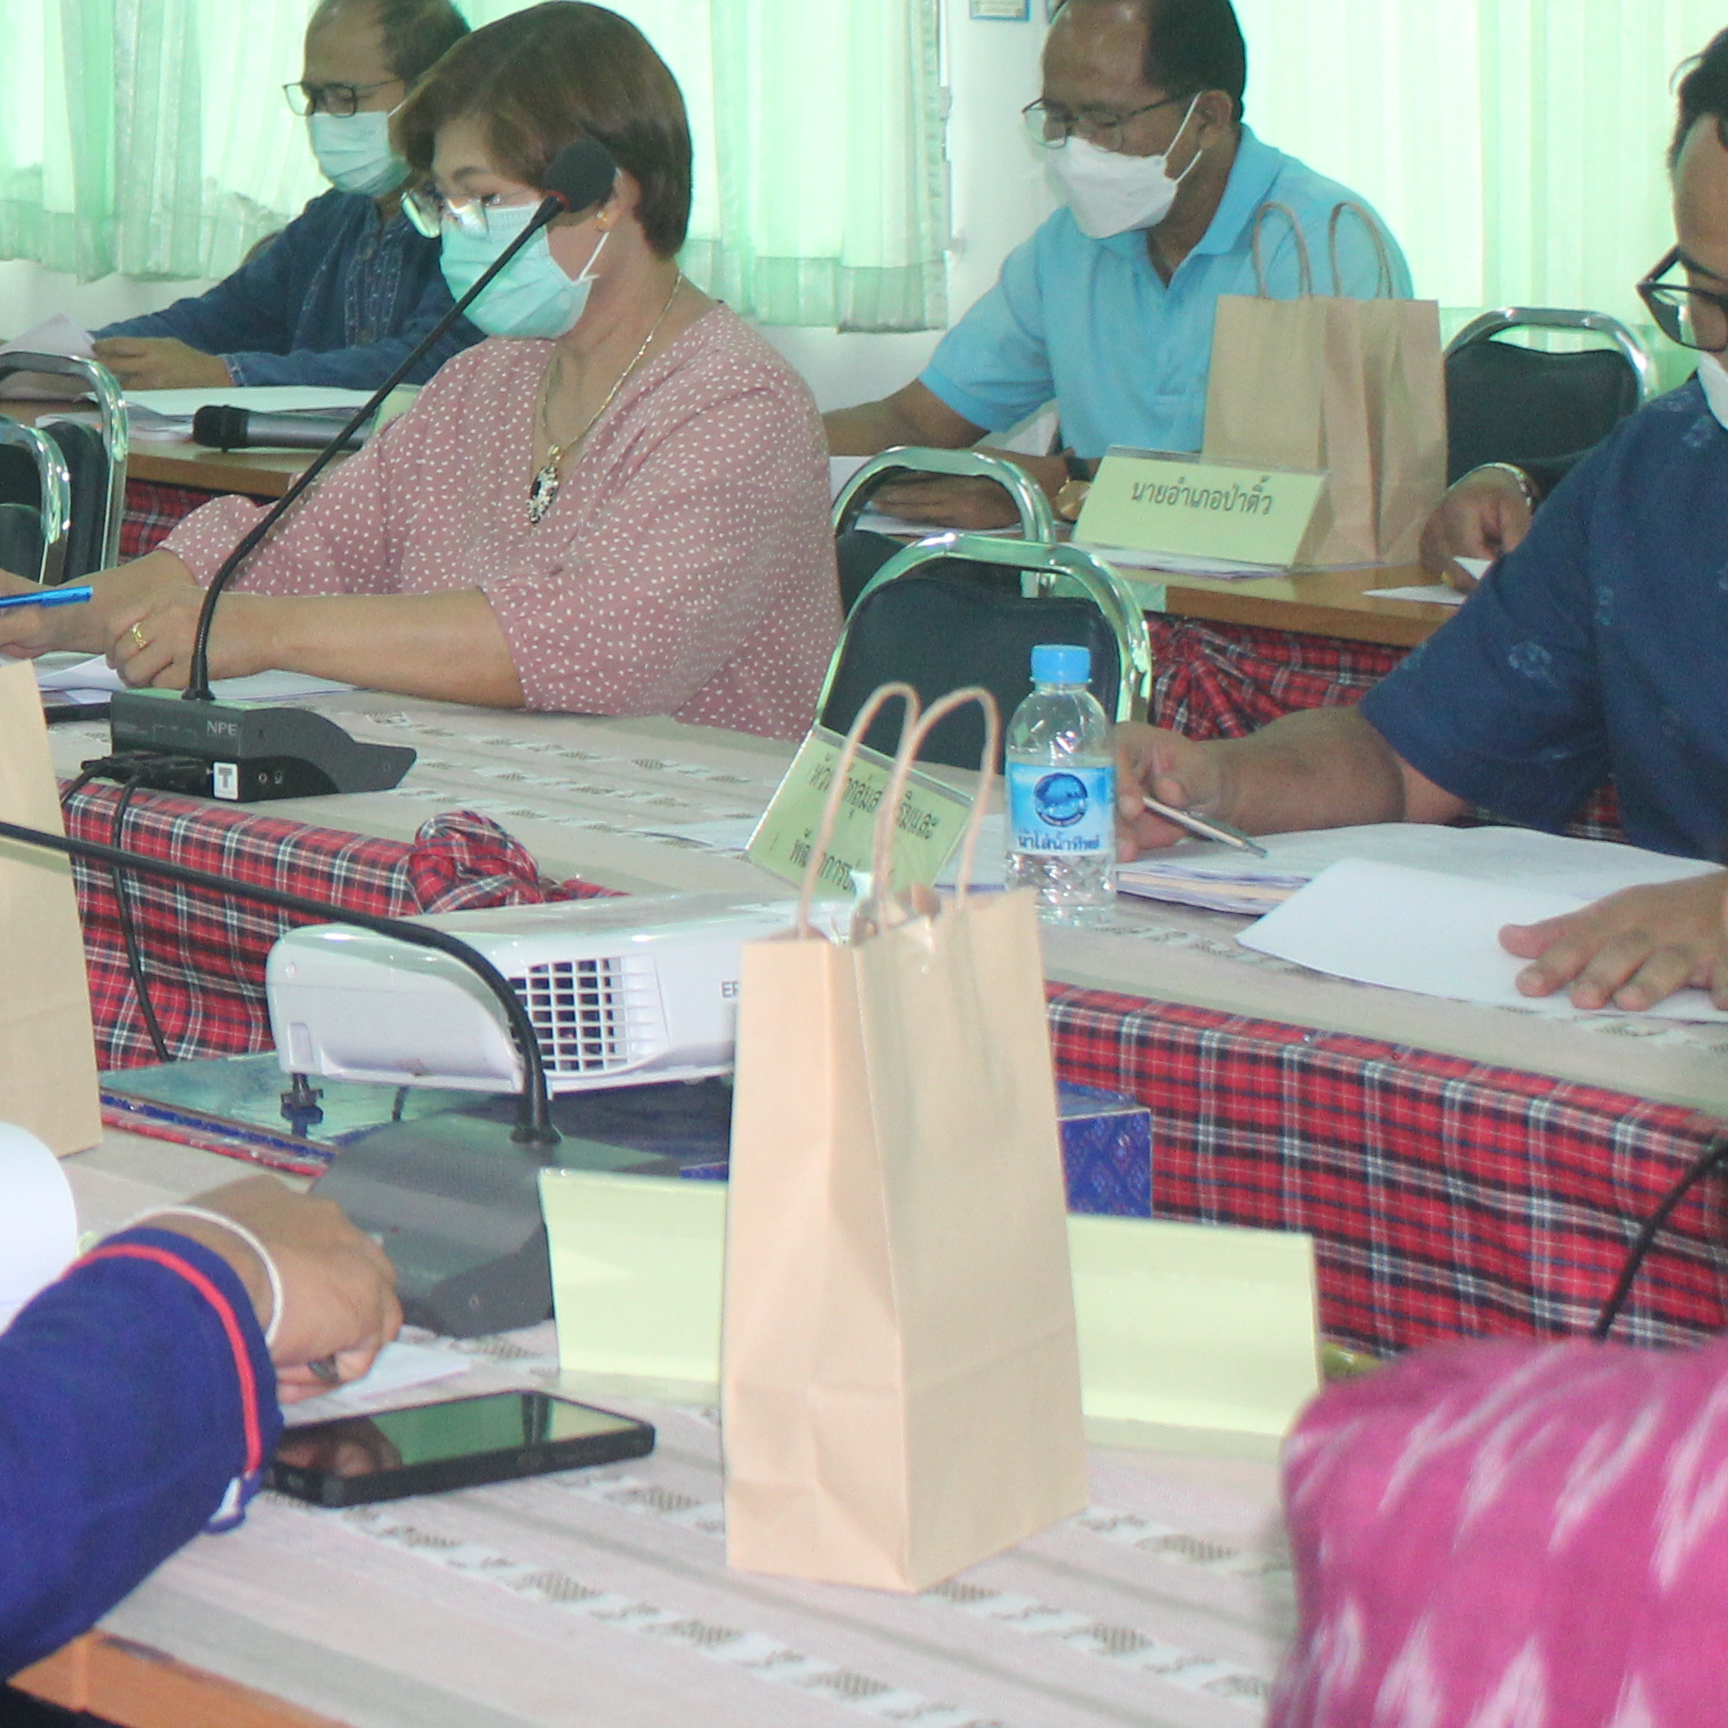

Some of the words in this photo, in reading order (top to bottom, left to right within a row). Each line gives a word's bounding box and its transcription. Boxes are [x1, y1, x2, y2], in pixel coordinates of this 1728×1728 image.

[1130, 475, 1273, 515] นายอำเภอป่าติ้ว
[206, 720, 238, 737] NPE
